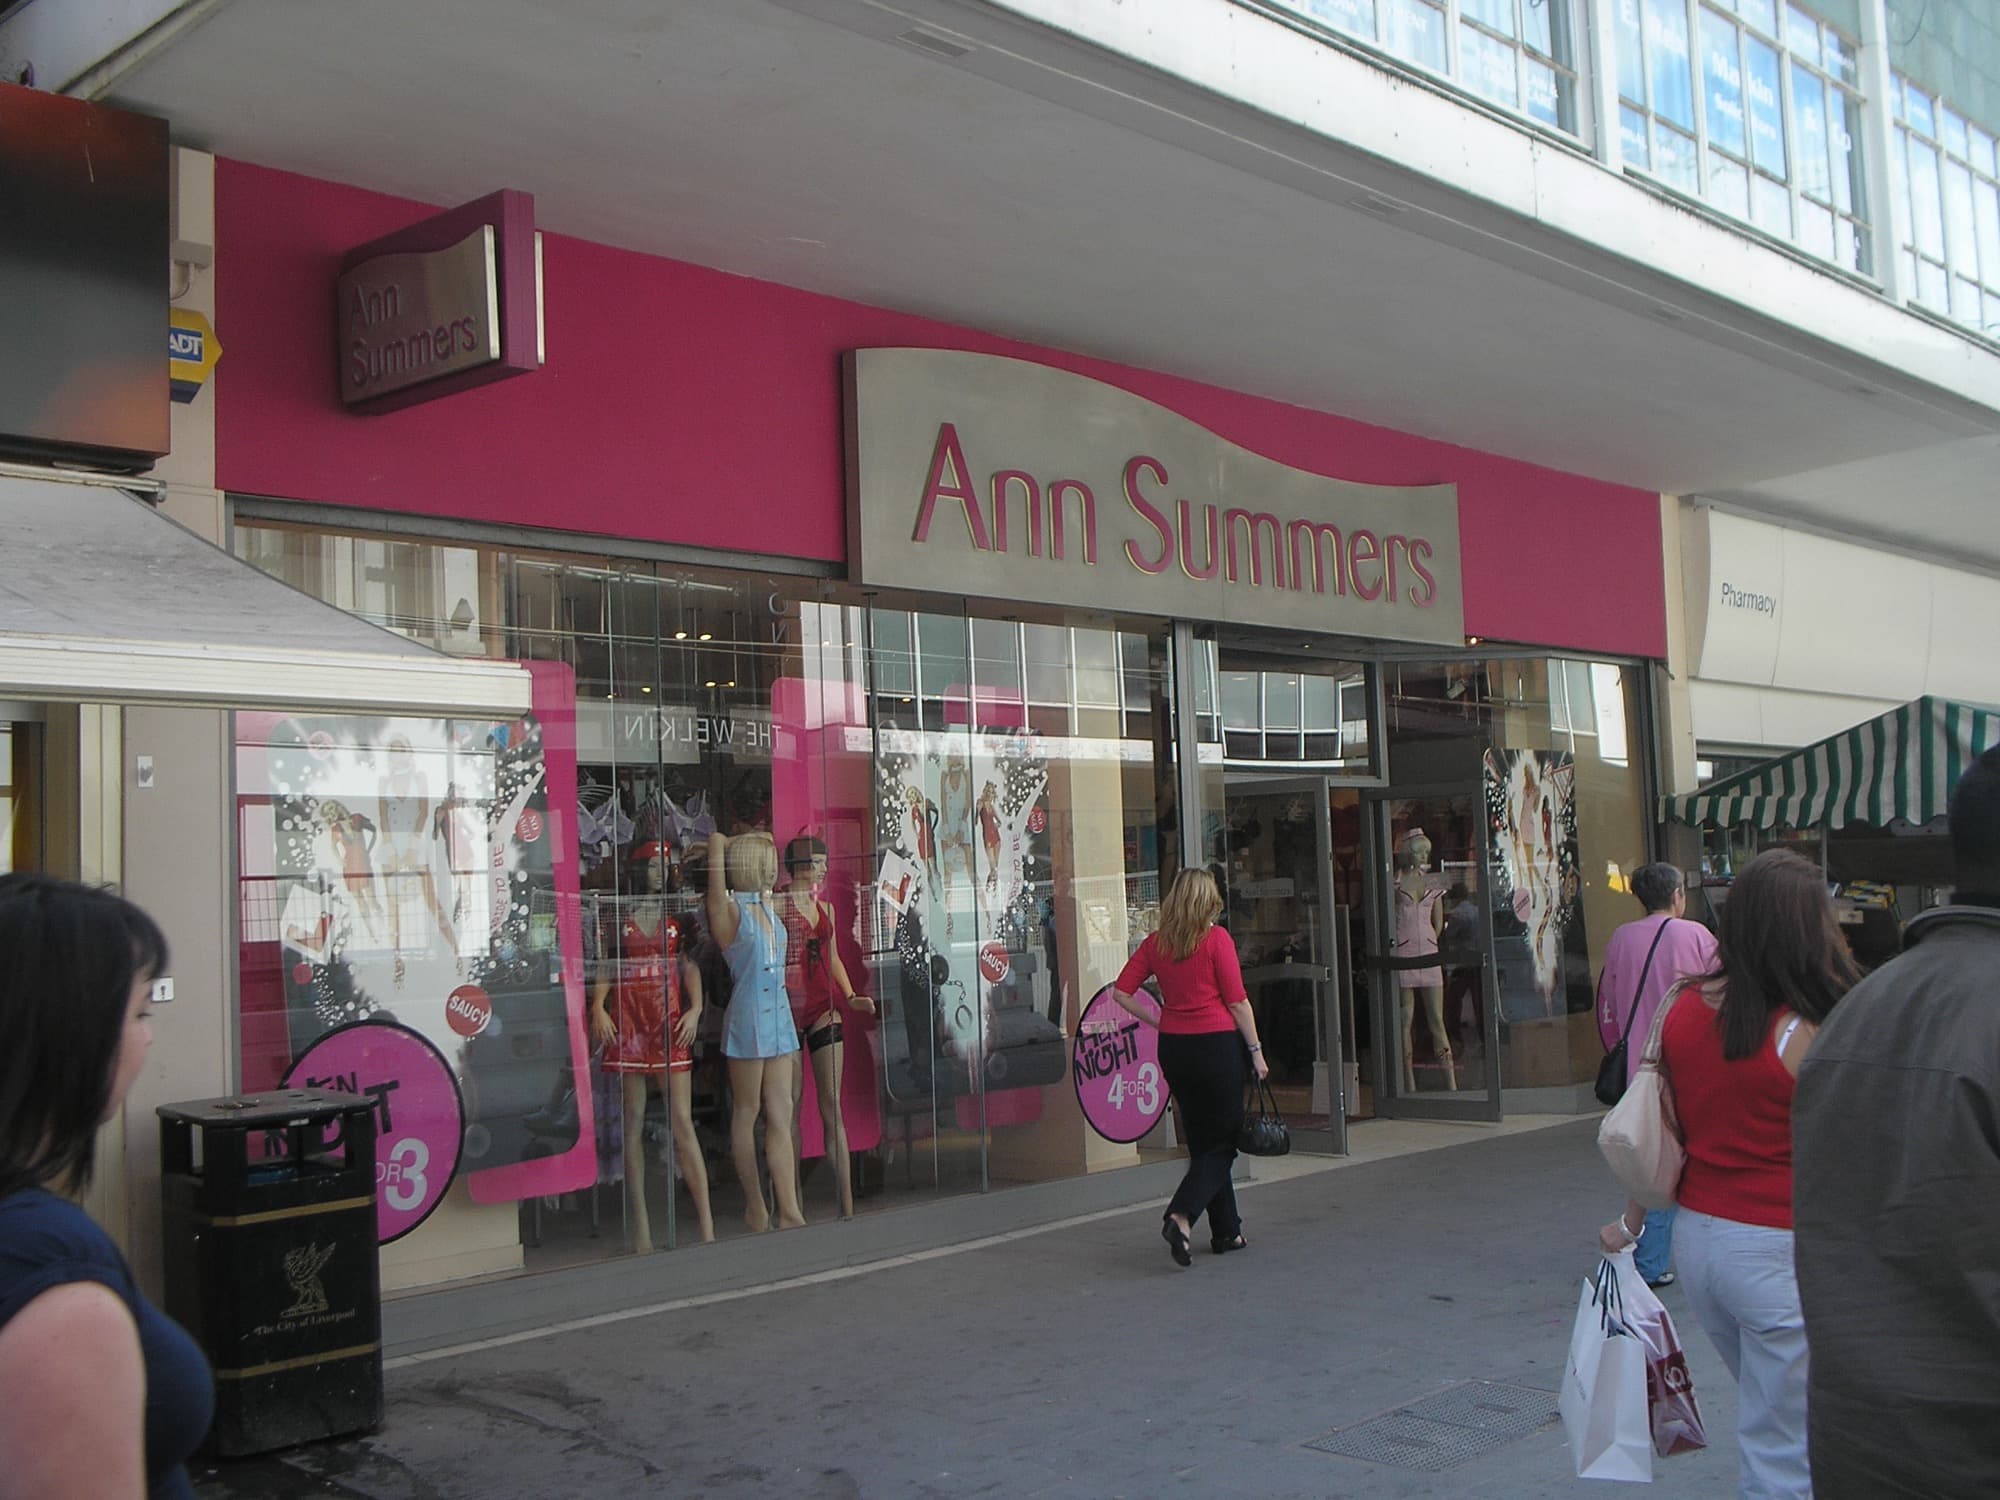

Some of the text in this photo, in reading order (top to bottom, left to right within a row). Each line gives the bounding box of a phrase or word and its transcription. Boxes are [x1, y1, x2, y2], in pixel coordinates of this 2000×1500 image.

[352, 283, 400, 327] Ann
[168, 334, 203, 357] ADT
[350, 315, 481, 387] Summers
[911, 422, 1438, 609] Ann Summers
[1721, 582, 1777, 619] Pharmacy
[981, 948, 1008, 976] SAUCY
[450, 994, 489, 1027] SAUCY
[1075, 1022, 1140, 1086] NIGHT
[1107, 1062, 1160, 1115] 4 FOR 3
[385, 1138, 430, 1211] 3
[277, 1320, 297, 1333] City
[311, 1307, 356, 1326] Liverpool
